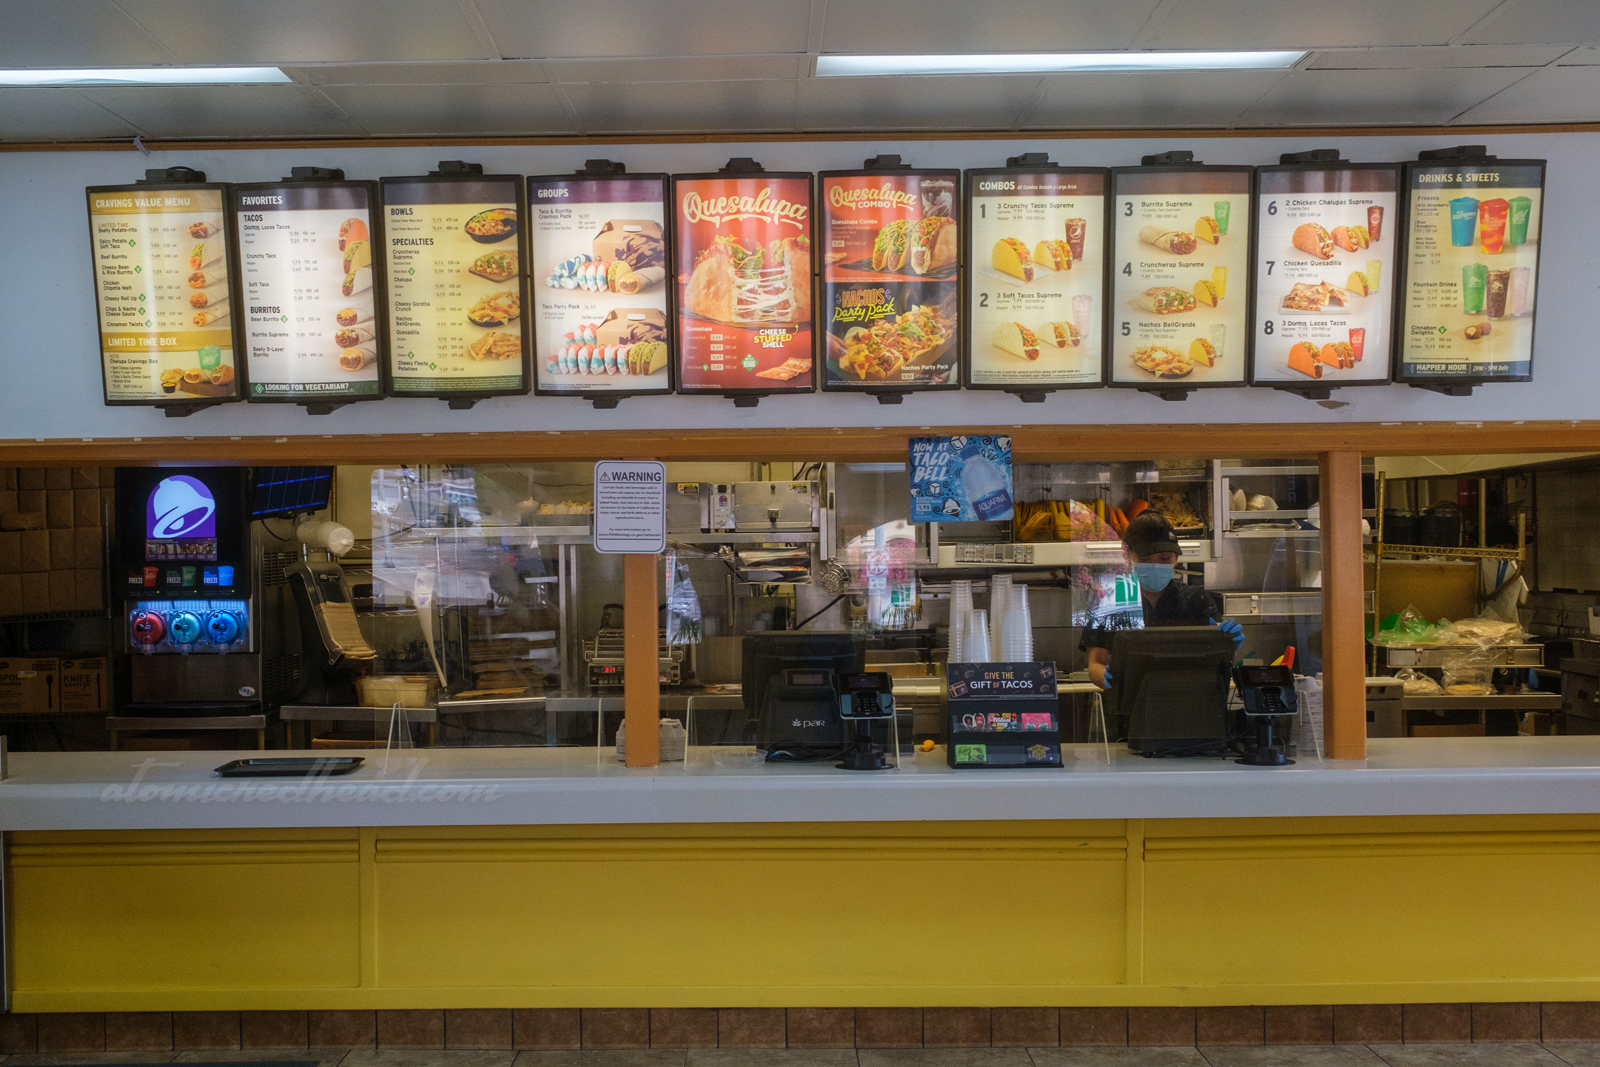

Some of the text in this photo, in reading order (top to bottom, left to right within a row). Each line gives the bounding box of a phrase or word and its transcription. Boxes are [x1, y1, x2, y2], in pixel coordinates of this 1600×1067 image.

[1419, 173, 1500, 183] DRINKS & SWEETS
[979, 181, 1015, 191] COMBOS
[538, 188, 569, 198] GROUPS
[830, 182, 918, 211] Quesalupa
[96, 198, 190, 208] CRAVINGS VALUE MENU
[242, 196, 283, 205] FAVORITES
[391, 208, 413, 216] BOWLS
[682, 187, 808, 229] Quesalupa
[980, 203, 985, 218] 1
[1124, 202, 1133, 217] 3
[1267, 200, 1277, 216] 6
[243, 214, 263, 222] TACOS
[392, 238, 434, 246] SPECIALTIES
[1122, 262, 1132, 277] 4
[1266, 261, 1276, 276] 7
[842, 288, 885, 308] NACHOS
[980, 292, 989, 307] 2
[832, 297, 896, 323] Party Pack
[1122, 322, 1131, 336] 5
[1264, 320, 1274, 335] 8
[108, 337, 177, 346] LIMITED TIME BOX
[753, 334, 792, 344] STUFFED
[305, 383, 349, 391] VEGETARIAN?
[913, 443, 949, 452] NOW AT
[913, 452, 950, 467] TACO
[611, 472, 661, 481] WARNING
[913, 466, 947, 483] BELL
[978, 494, 1007, 512] AQUAFINA
[63, 675, 91, 683] KNIFE
[984, 672, 1000, 680] GIVE
[970, 681, 991, 689] GIFT
[1001, 680, 1033, 689] TACOS
